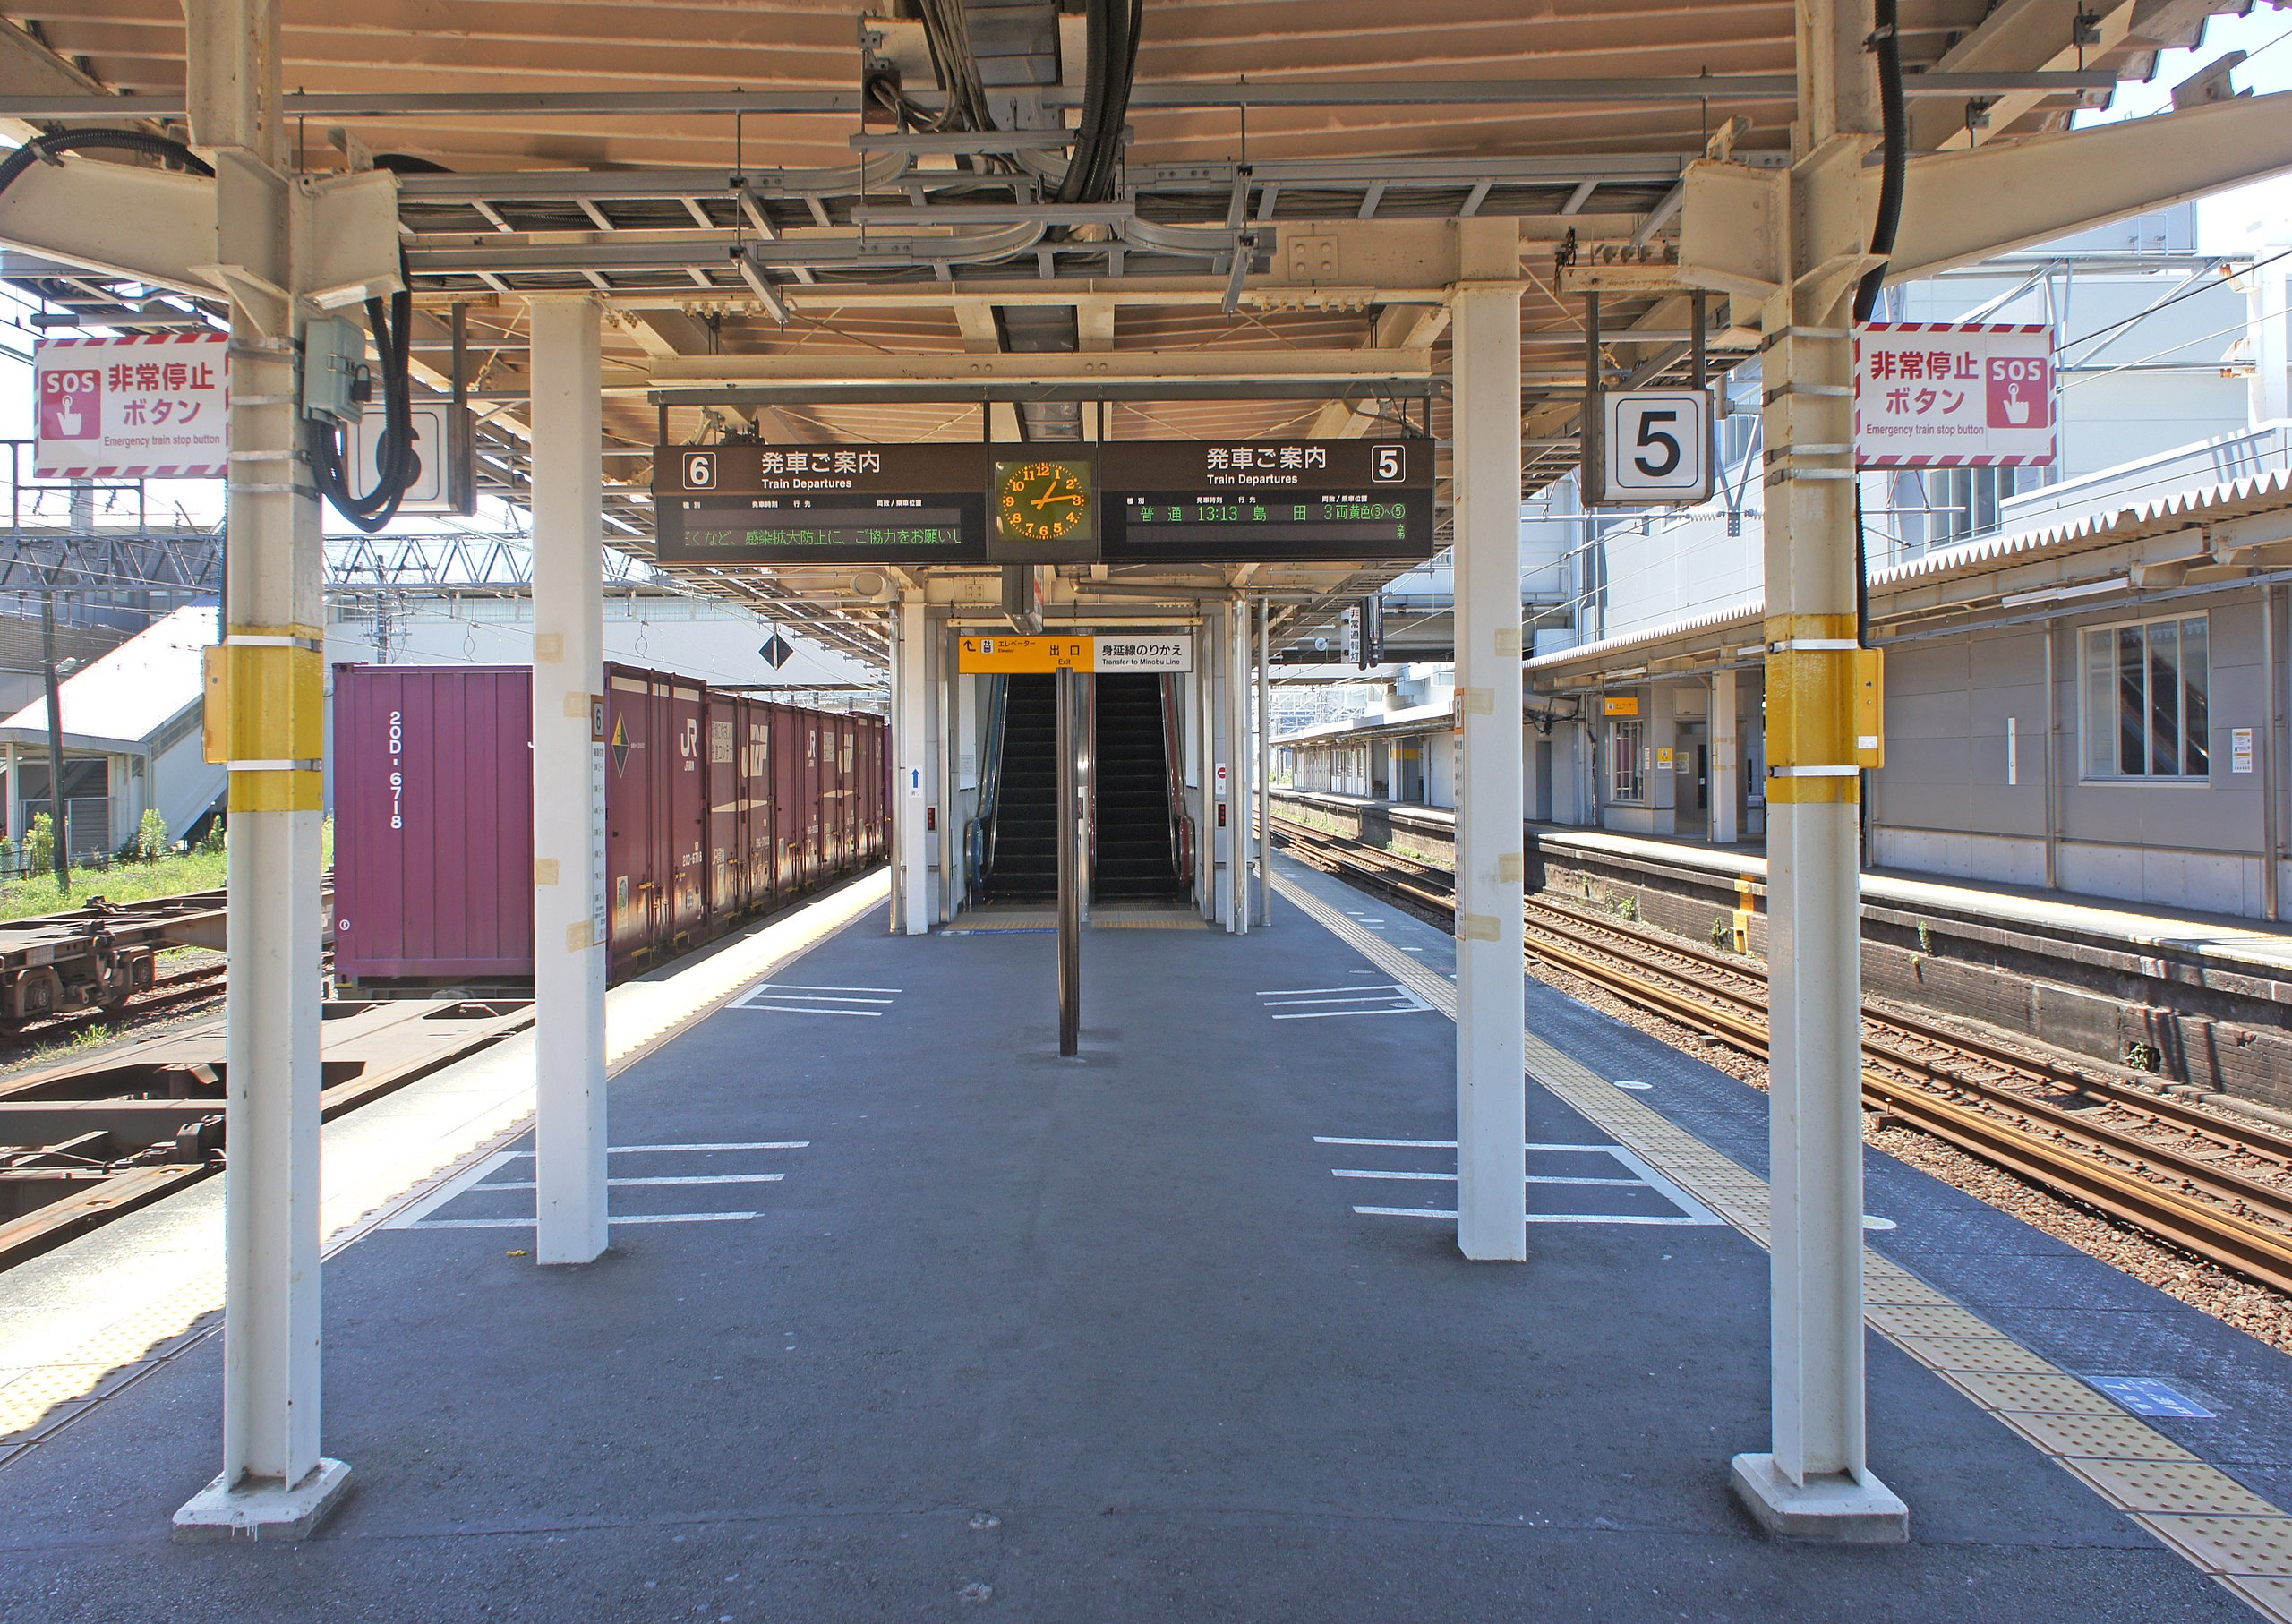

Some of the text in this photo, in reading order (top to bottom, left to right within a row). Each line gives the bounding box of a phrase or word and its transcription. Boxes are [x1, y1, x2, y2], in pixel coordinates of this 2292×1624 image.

[1870, 351, 1979, 380] 非常停止
[1992, 360, 2041, 381] SOS
[47, 372, 94, 392] SOS
[108, 363, 215, 390] 非常停止
[1886, 387, 1964, 415] ボタン
[123, 399, 201, 426] ボタン
[1866, 423, 1985, 437] Emergency train stop button
[103, 434, 220, 449] Emergency train stop button
[1634, 410, 1681, 477] 5
[761, 450, 881, 474] 発車ご案内
[1206, 446, 1327, 470] 発車ご案内
[1378, 449, 1398, 478] 5
[689, 457, 710, 485] 6
[1023, 470, 1035, 481] 11
[1037, 466, 1049, 476] 12
[1055, 469, 1061, 480] 1
[761, 478, 852, 491] Train Departures
[1012, 481, 1025, 491] 10
[1065, 479, 1075, 490] 2
[1207, 474, 1298, 487] Train Departures
[1005, 496, 1015, 507] 9
[1073, 495, 1082, 506] 3
[1013, 513, 1022, 524] 8
[1065, 512, 1075, 523] 4
[1198, 505, 1239, 522] 13:13
[1025, 523, 1035, 534] 7
[1039, 526, 1048, 536] 6
[1053, 522, 1063, 533] 5
[997, 639, 1036, 647] エレベーター
[1049, 645, 1081, 656] 出口
[1102, 644, 1183, 656] 身延線のりかえ
[595, 709, 602, 731] 6
[680, 718, 697, 757] JR
